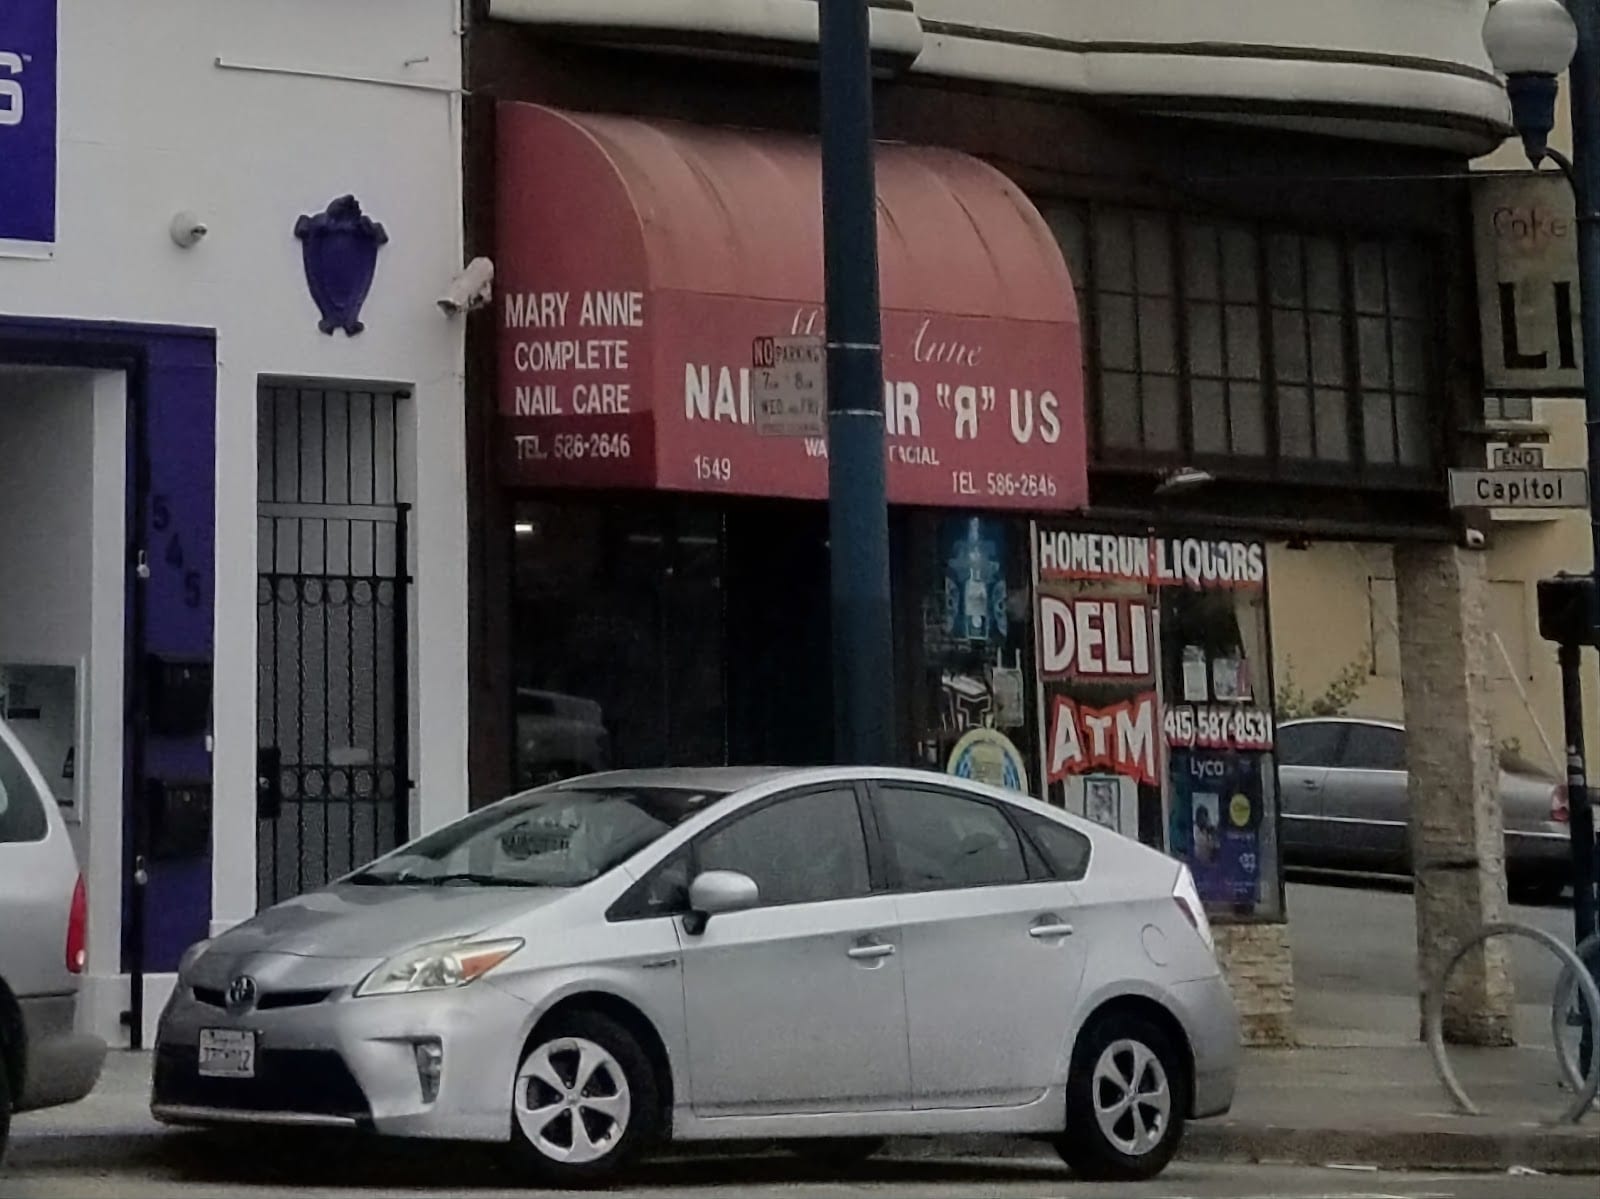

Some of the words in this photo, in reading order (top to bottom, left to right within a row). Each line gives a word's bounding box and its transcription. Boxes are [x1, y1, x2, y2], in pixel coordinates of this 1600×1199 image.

[505, 291, 569, 328] MARY
[579, 291, 644, 327] ANNE
[514, 340, 629, 372] COMPLETE
[754, 338, 774, 367] NO
[515, 386, 562, 416] NAIL
[572, 384, 631, 414] CARE
[685, 362, 755, 425] NAI
[1009, 388, 1061, 444] US
[554, 433, 631, 459] 586-2646
[694, 456, 731, 481] 1549
[987, 472, 1057, 497] 586-2646
[1476, 477, 1563, 505] Capitol
[1039, 531, 1149, 577] HOMERUN
[1155, 538, 1264, 585] LIQUORS
[1041, 597, 1150, 675] DELI
[1051, 699, 1155, 778] ATM
